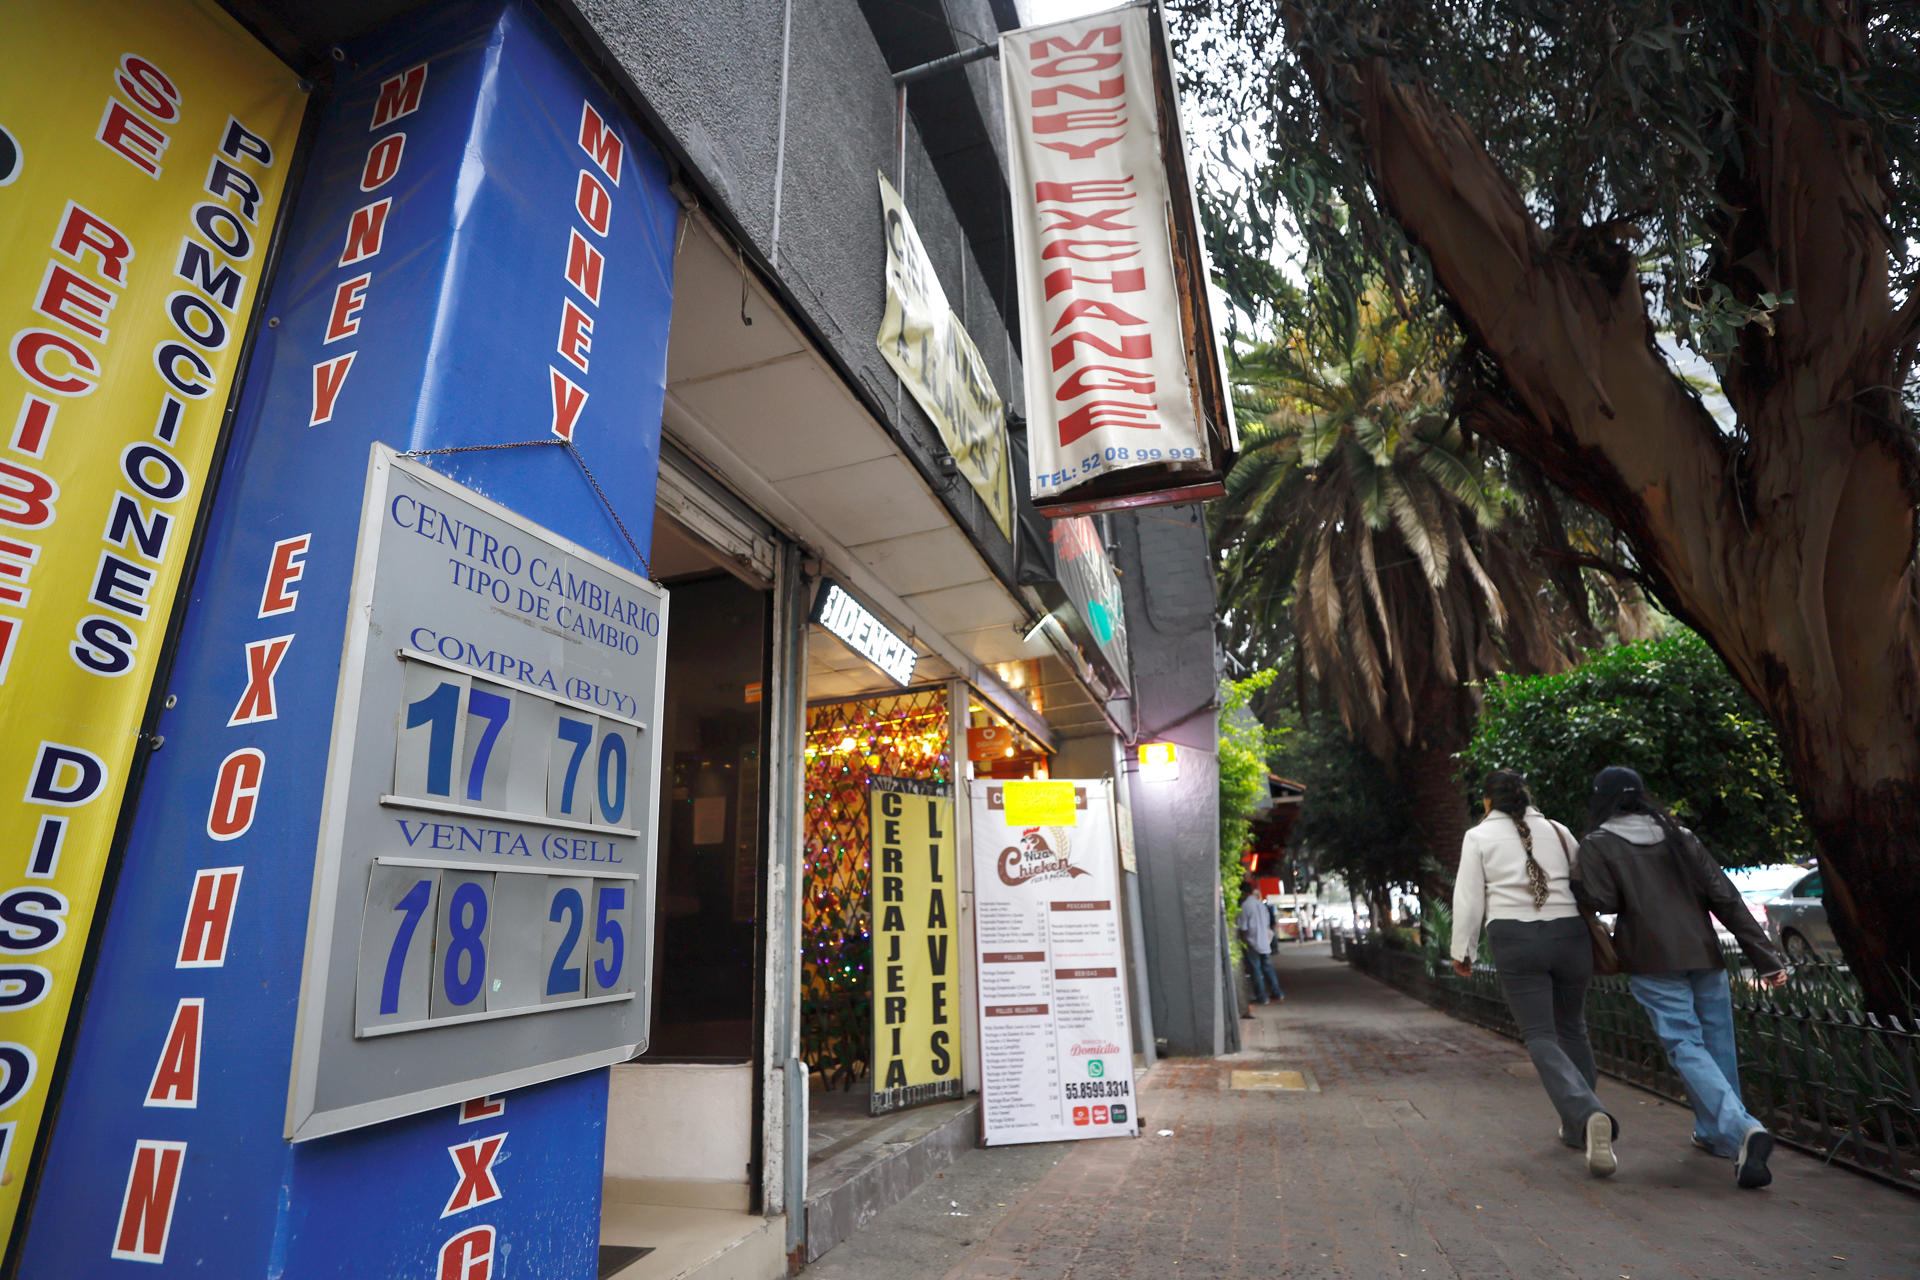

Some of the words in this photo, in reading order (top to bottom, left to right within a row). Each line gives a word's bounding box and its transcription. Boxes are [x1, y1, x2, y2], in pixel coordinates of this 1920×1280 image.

[96, 53, 181, 180] SE
[1030, 24, 1128, 160] MONEY
[309, 63, 427, 427] MONEY
[549, 99, 623, 443] MONEY
[1035, 174, 1161, 447] EXCHANGE
[0, 200, 135, 686] RECIBE
[69, 114, 273, 678] PROMOCIONES
[1037, 467, 1077, 488] TEL:
[1082, 453, 1102, 473] 52
[1105, 447, 1129, 461] 08
[1136, 449, 1162, 461] 99
[1169, 447, 1195, 459] 99
[391, 494, 522, 575] CENTRO
[529, 558, 660, 638] CAMBIARIO
[449, 558, 510, 604] TIPO
[518, 587, 549, 622] DE
[556, 606, 639, 657] CAMBIO
[410, 627, 559, 692] COMPRA
[565, 676, 637, 719] (BUY)
[406, 682, 511, 802] 17
[556, 716, 627, 824] 70
[395, 819, 532, 858] VENTA
[540, 831, 624, 864] (SELL
[997, 846, 1072, 887] Chicken
[0, 740, 109, 1182] DISPO
[379, 879, 488, 1015] 18
[546, 886, 626, 997] 25
[881, 792, 908, 1089] CERRAJERIA
[927, 801, 951, 1076] LLAVES
[1065, 1080, 1129, 1099] 55.8599.3314
[1070, 1042, 1120, 1056] Domicilio
